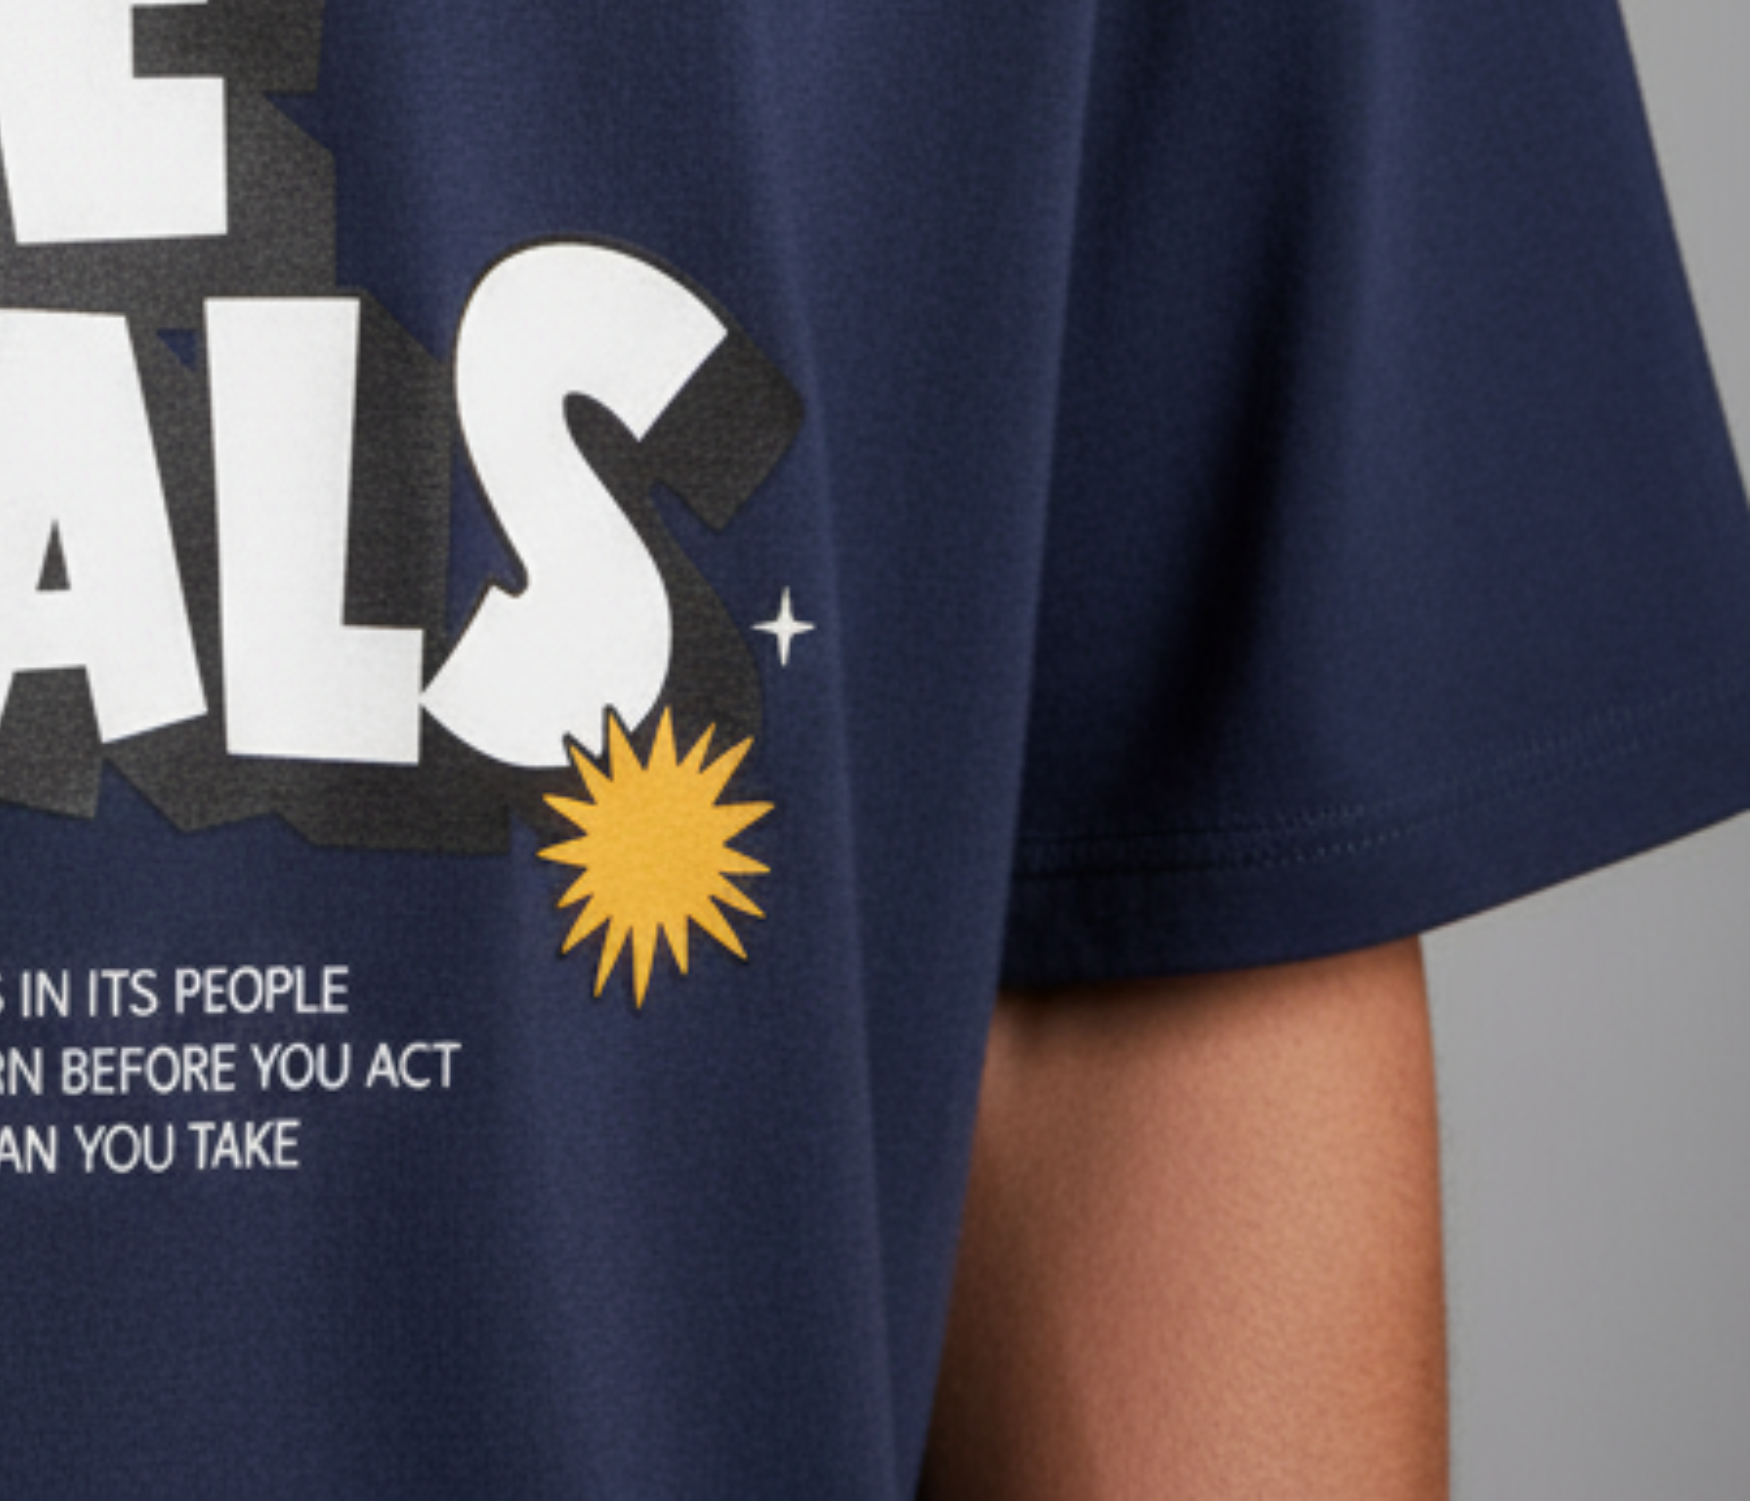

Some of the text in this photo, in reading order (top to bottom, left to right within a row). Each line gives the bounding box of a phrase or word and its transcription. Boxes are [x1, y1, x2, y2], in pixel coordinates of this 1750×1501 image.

[21, 969, 69, 1018] IN
[88, 968, 159, 1017] ITS
[175, 965, 349, 1014] PEOPLE
[61, 1043, 236, 1095] BEFORE
[251, 1042, 351, 1091] YOU
[365, 1041, 462, 1089] ACT
[74, 1123, 175, 1174] YOU
[187, 1119, 301, 1170] TAKE
